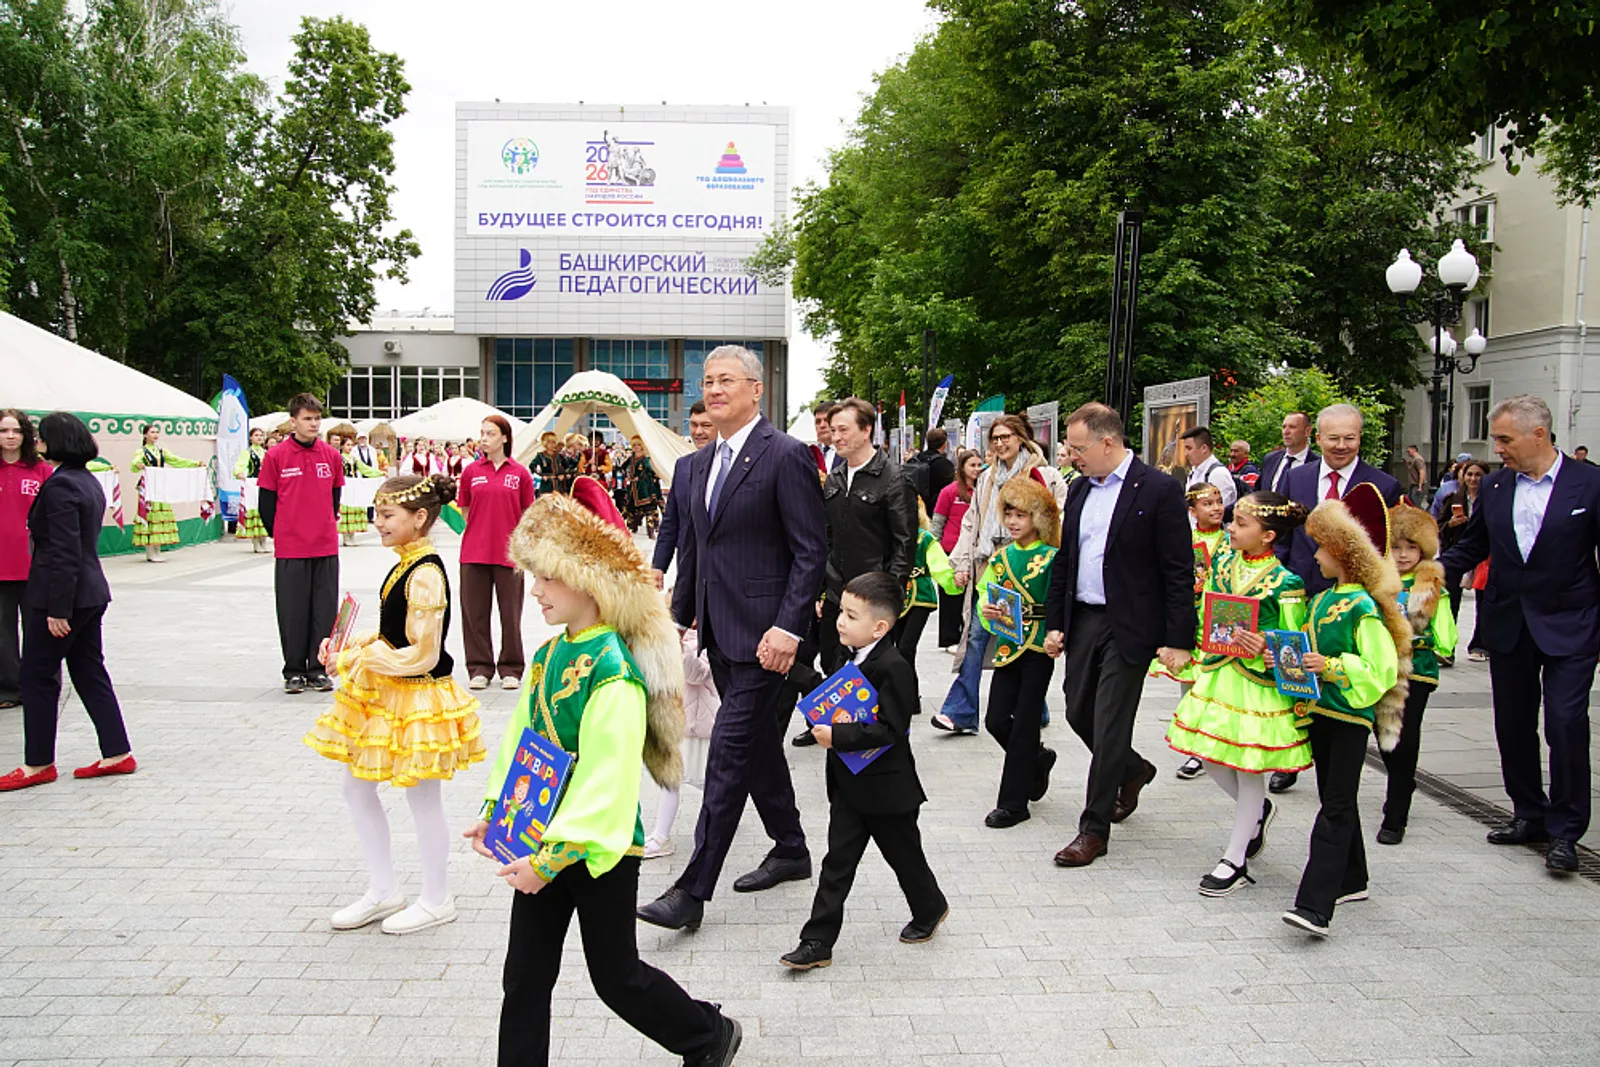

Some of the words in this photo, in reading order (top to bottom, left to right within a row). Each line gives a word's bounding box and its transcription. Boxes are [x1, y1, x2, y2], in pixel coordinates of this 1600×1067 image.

[585, 146, 608, 163] 20
[585, 164, 608, 181] 26
[478, 213, 566, 228] БУДУЩЕЕ
[572, 213, 666, 228] СТРОИТСЯ
[673, 214, 762, 231] СЕГОДНЯ!
[560, 251, 706, 272] БАШКИРСКИЙ
[559, 274, 758, 296] ПЕДАГОГИЧЕСКИЙ
[808, 677, 864, 722] БУКВАРЬ
[515, 746, 559, 788] БУКВАРЬ
